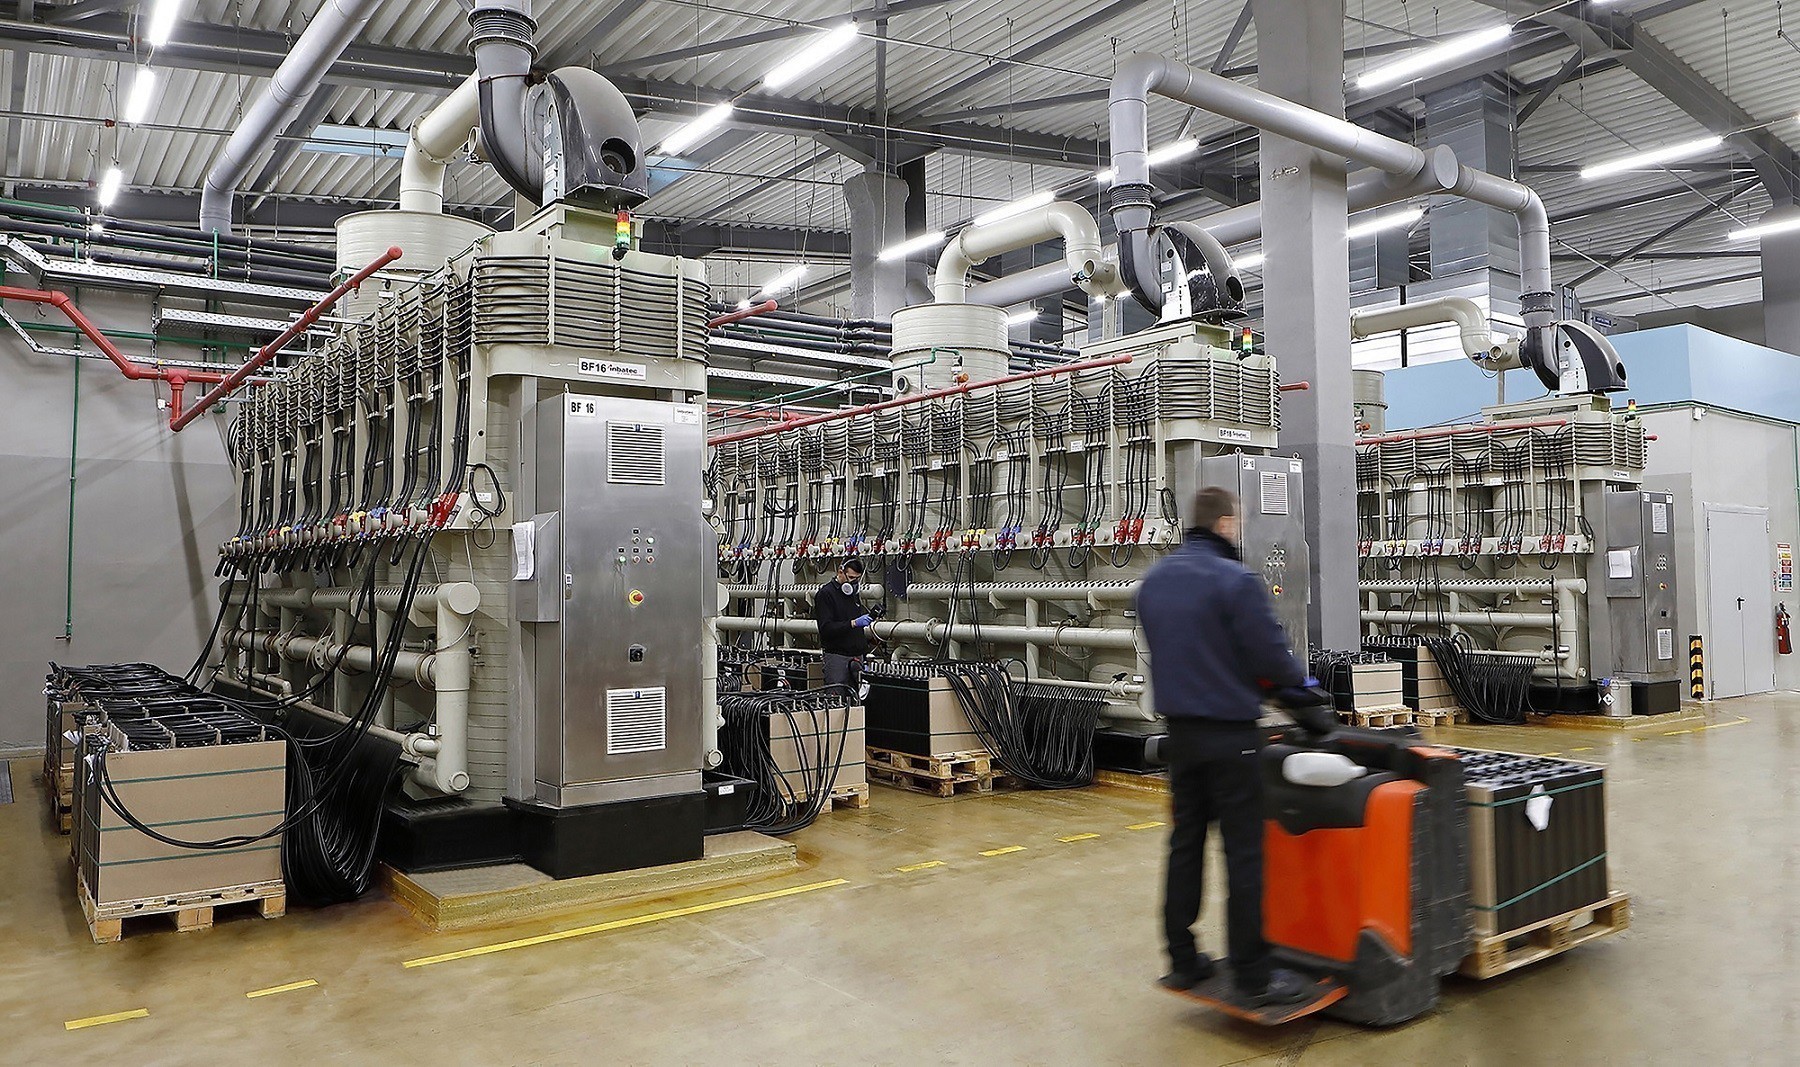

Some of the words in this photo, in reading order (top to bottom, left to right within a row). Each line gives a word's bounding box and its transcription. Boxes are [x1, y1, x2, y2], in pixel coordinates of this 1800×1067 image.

[581, 361, 606, 373] BF16
[608, 364, 638, 374] inbatec
[571, 402, 581, 413] BF
[586, 403, 594, 413] 16
